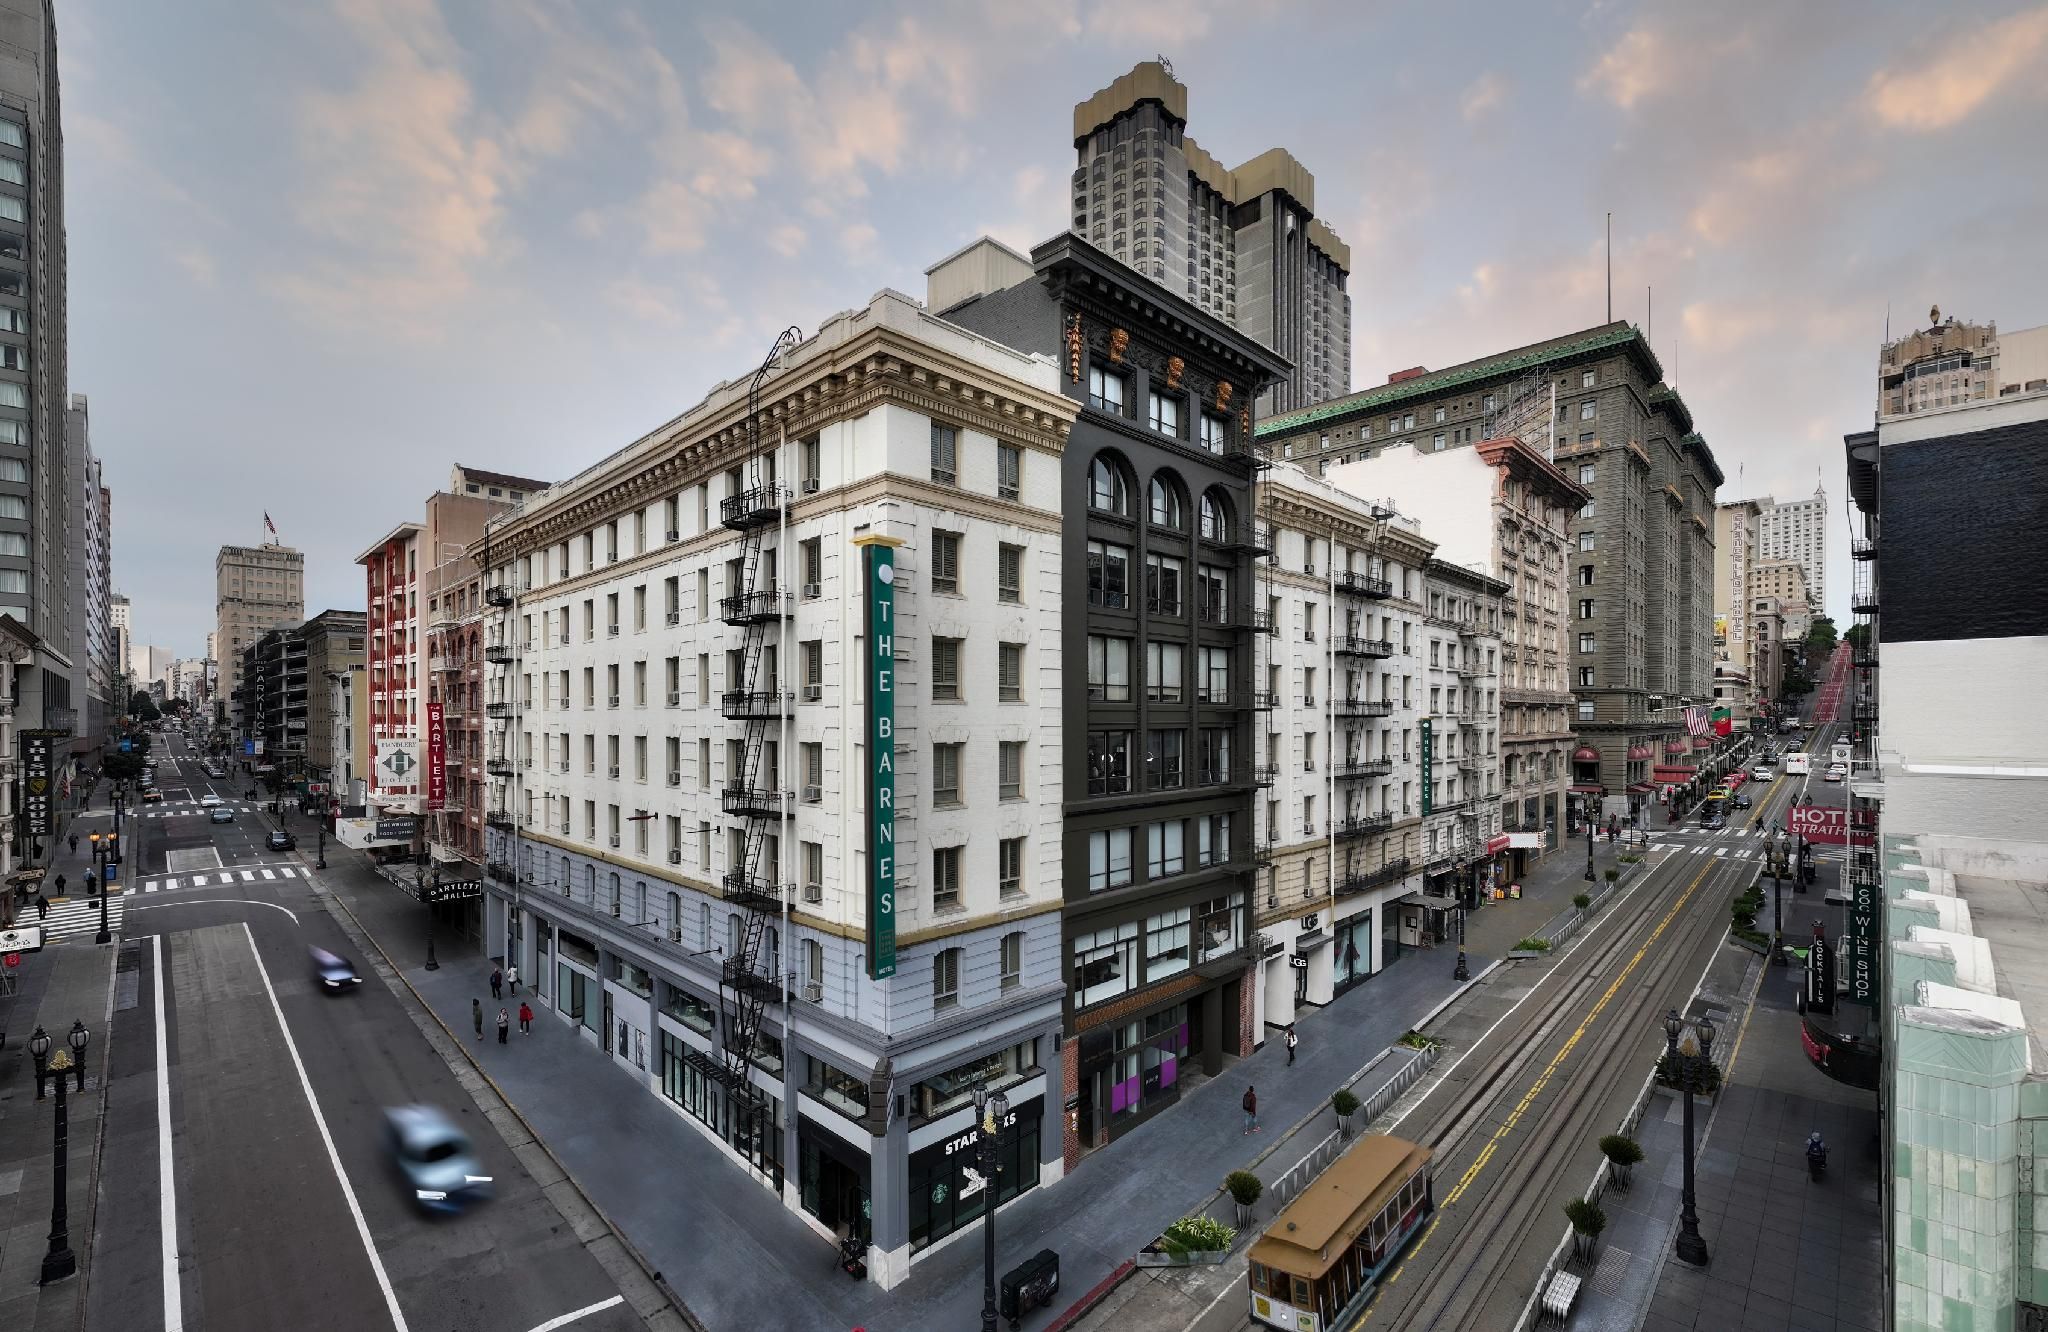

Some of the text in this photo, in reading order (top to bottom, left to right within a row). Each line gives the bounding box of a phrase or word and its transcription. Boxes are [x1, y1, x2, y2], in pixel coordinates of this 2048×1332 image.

[1732, 599, 1743, 641] HOTEL
[256, 665, 265, 730] PARKING
[27, 739, 48, 777] IRISH
[431, 711, 443, 797] BARTLETT
[878, 600, 892, 914] THE BARNES
[27, 795, 48, 833] HOUSE
[443, 891, 467, 900] HALL
[1290, 956, 1307, 967] UGG
[1816, 940, 1824, 1003] COCKTAILS
[1855, 960, 1870, 999] SHOP
